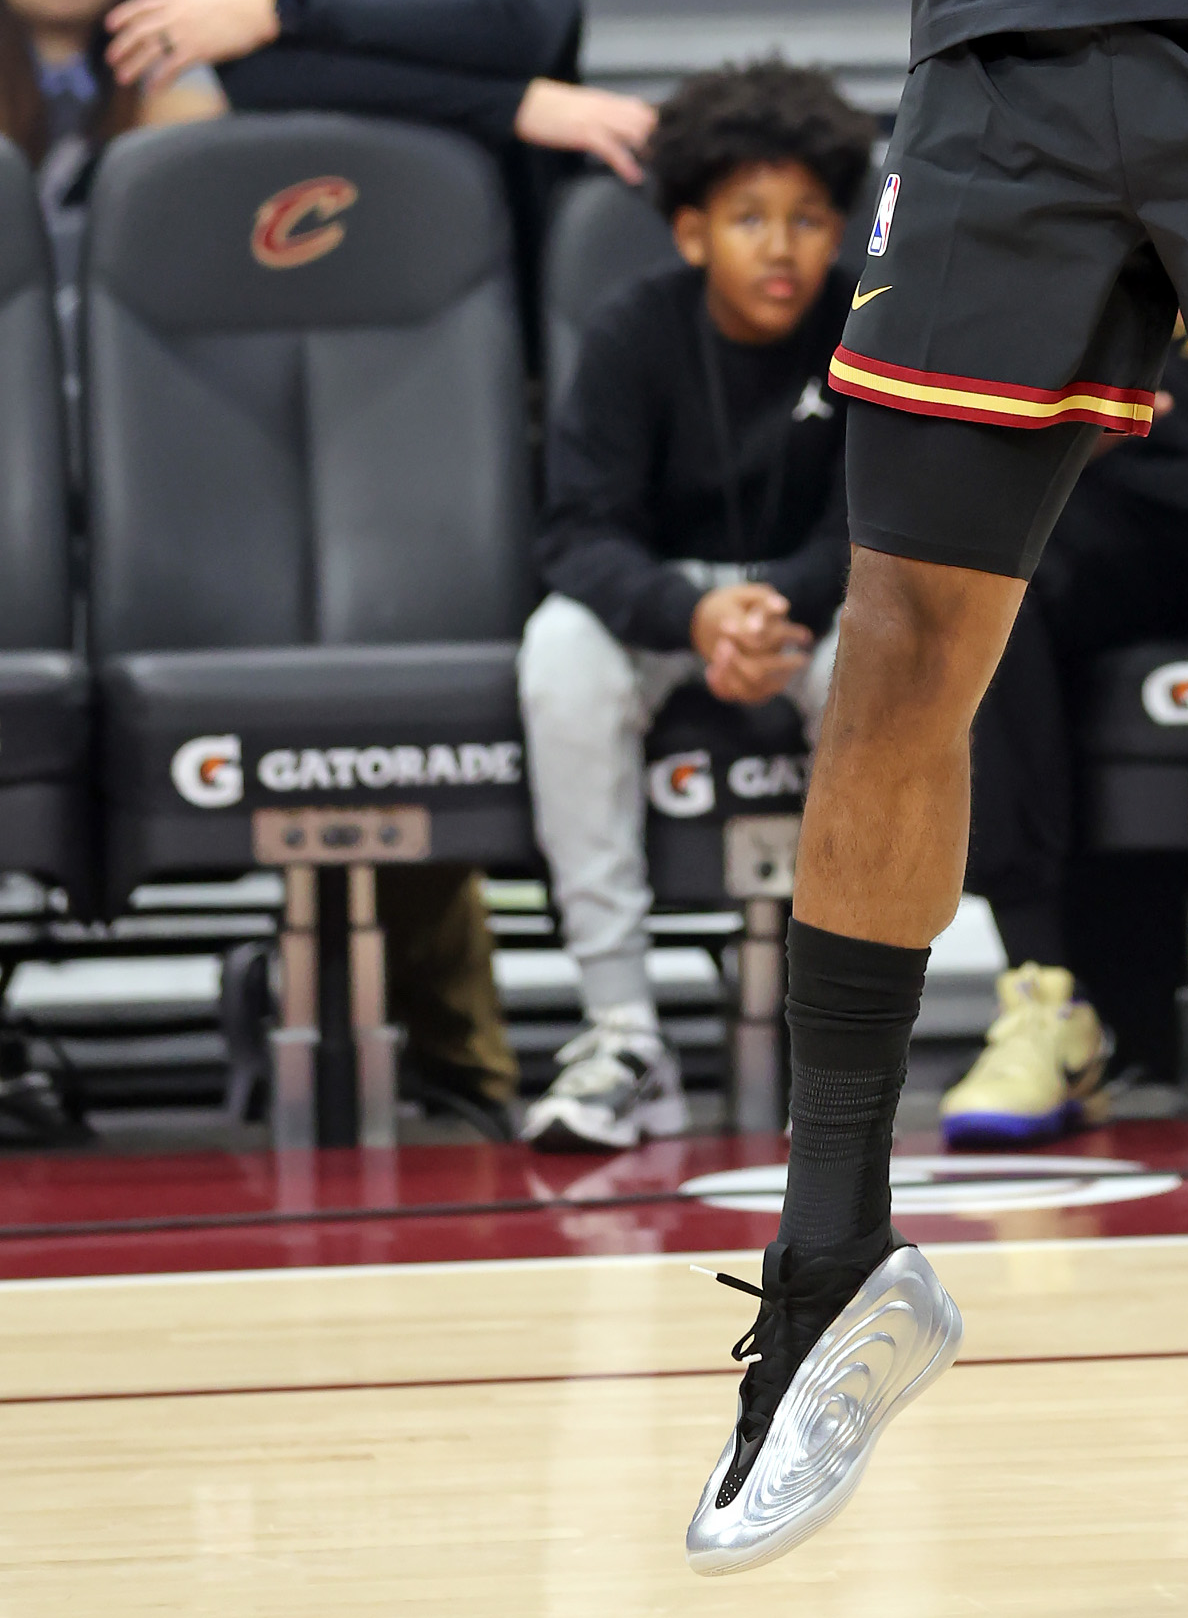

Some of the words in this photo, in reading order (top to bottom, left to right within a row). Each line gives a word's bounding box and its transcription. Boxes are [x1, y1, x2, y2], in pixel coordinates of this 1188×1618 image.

[250, 175, 359, 270] C
[170, 734, 245, 809] G
[257, 740, 523, 793] GATORADE
[650, 748, 716, 818] G
